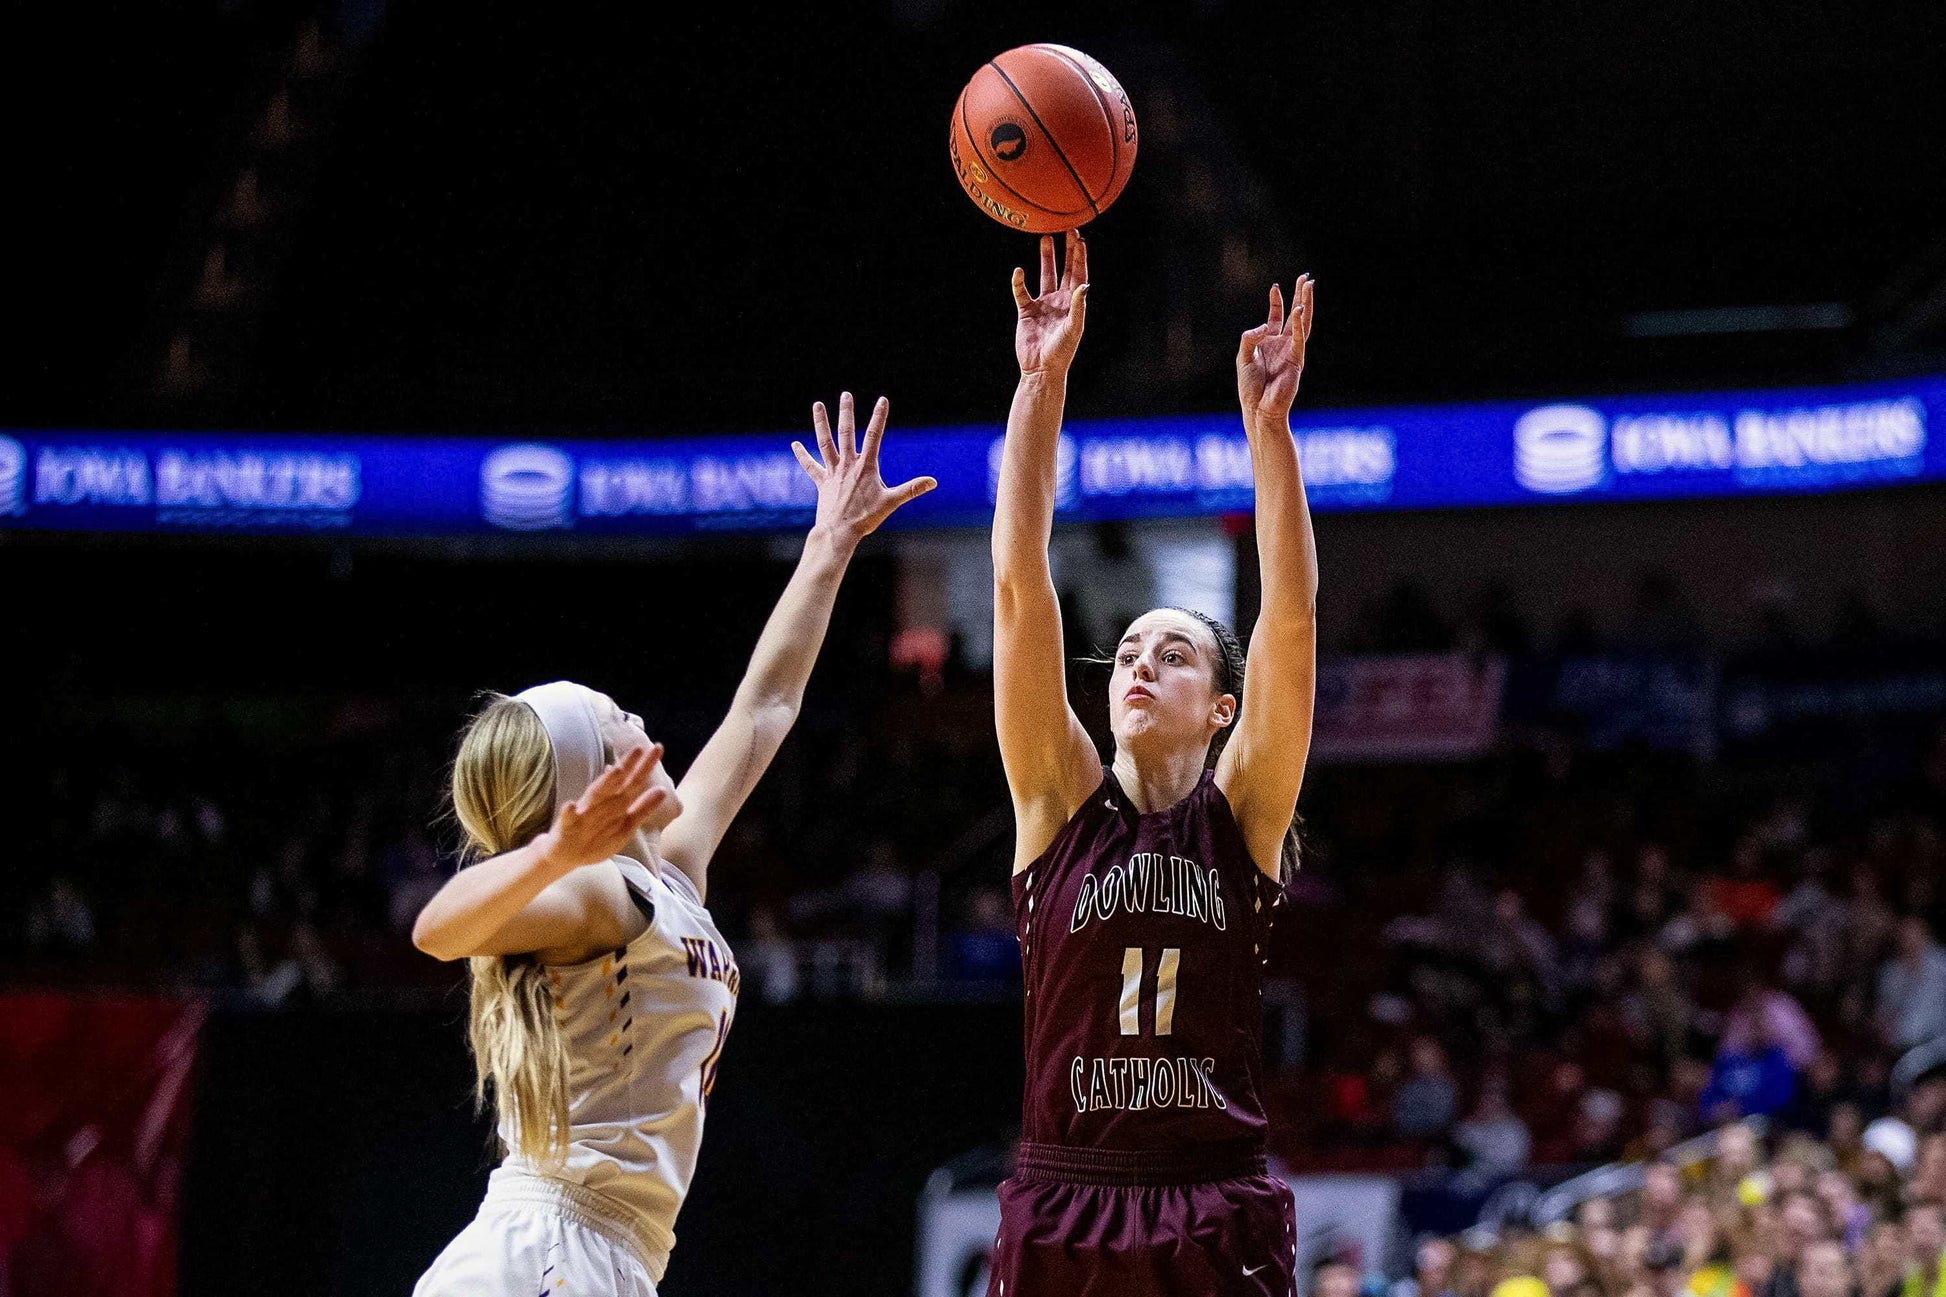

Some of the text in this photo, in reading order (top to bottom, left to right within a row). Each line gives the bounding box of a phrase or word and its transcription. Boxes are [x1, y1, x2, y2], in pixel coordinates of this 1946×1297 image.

[1070, 852, 1226, 934] DOWLING
[1119, 947, 1181, 1036] 11
[1070, 1055, 1227, 1113] CATHOLIC
